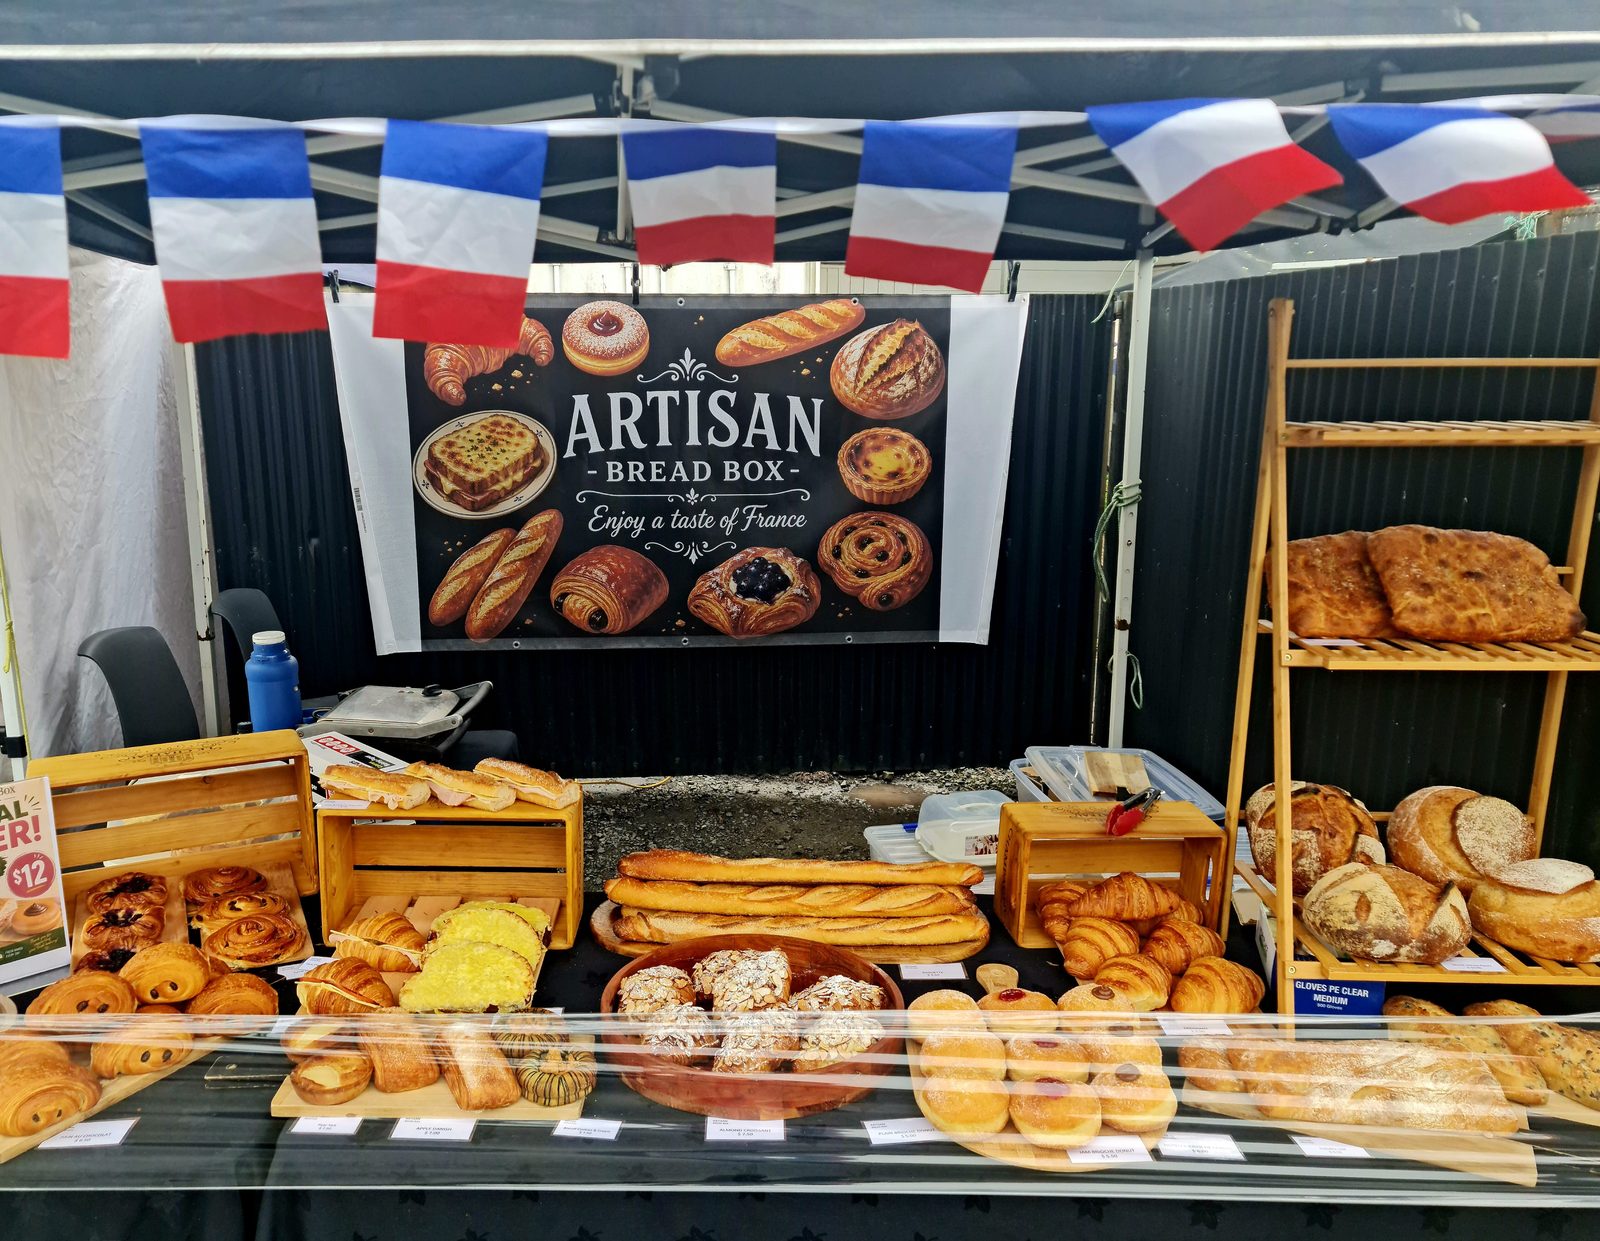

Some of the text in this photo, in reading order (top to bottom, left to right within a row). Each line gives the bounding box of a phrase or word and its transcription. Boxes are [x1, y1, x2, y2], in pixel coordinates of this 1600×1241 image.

[563, 390, 824, 458] ARTISAN
[606, 460, 784, 482] BREAD BOX
[588, 504, 807, 538] Enjoy a taste of France
[13, 860, 48, 889] $12
[1295, 981, 1369, 997] GLOVES PE CLEAR
[1313, 994, 1348, 1005] MEDIUM
